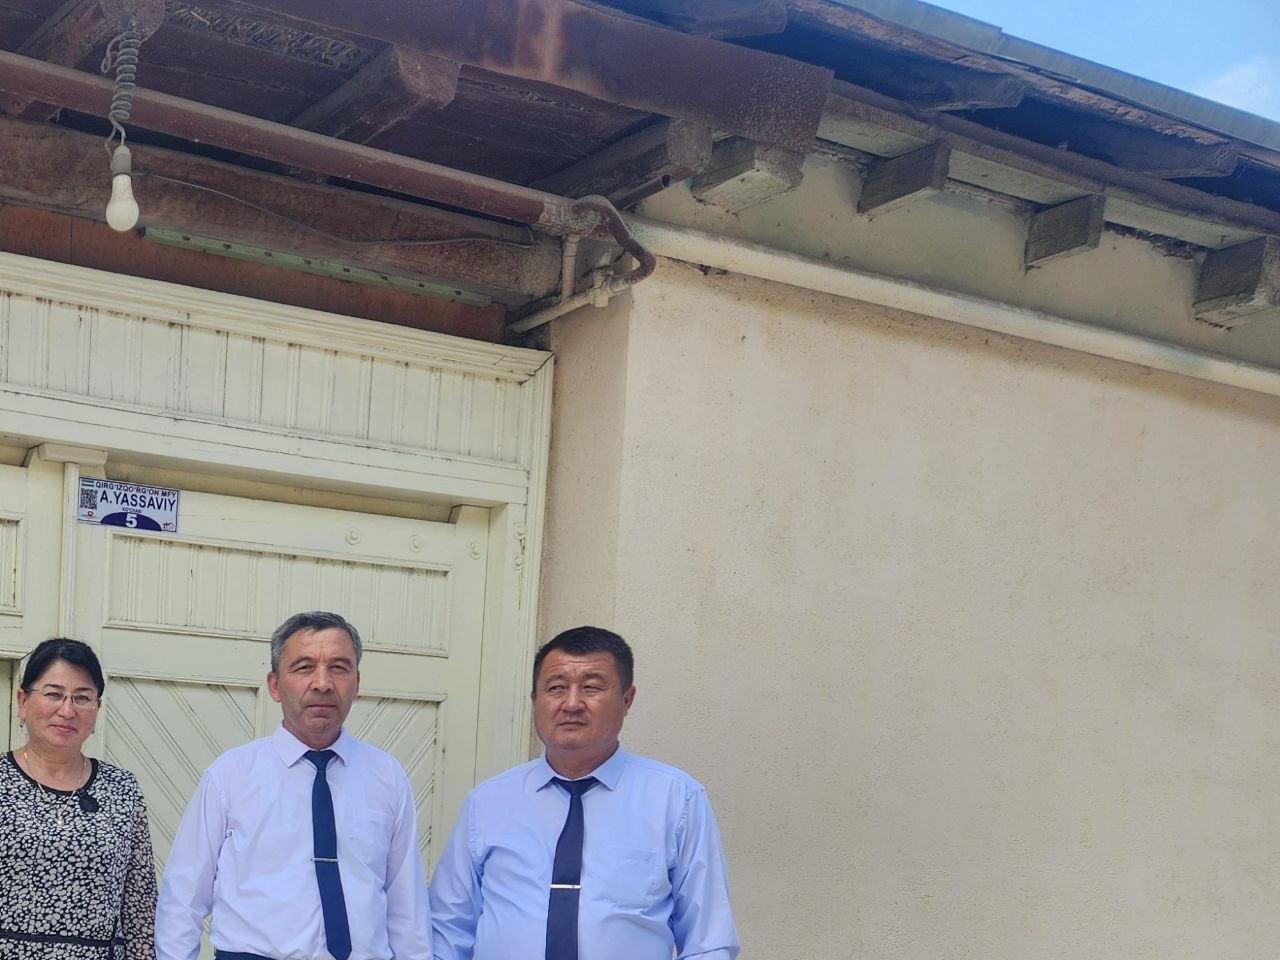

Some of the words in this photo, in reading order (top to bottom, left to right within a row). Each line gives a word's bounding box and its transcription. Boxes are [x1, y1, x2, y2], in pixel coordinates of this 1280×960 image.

[100, 490, 176, 512] A.YASSAVIY
[161, 490, 176, 498] MFY
[125, 513, 138, 528] 5
